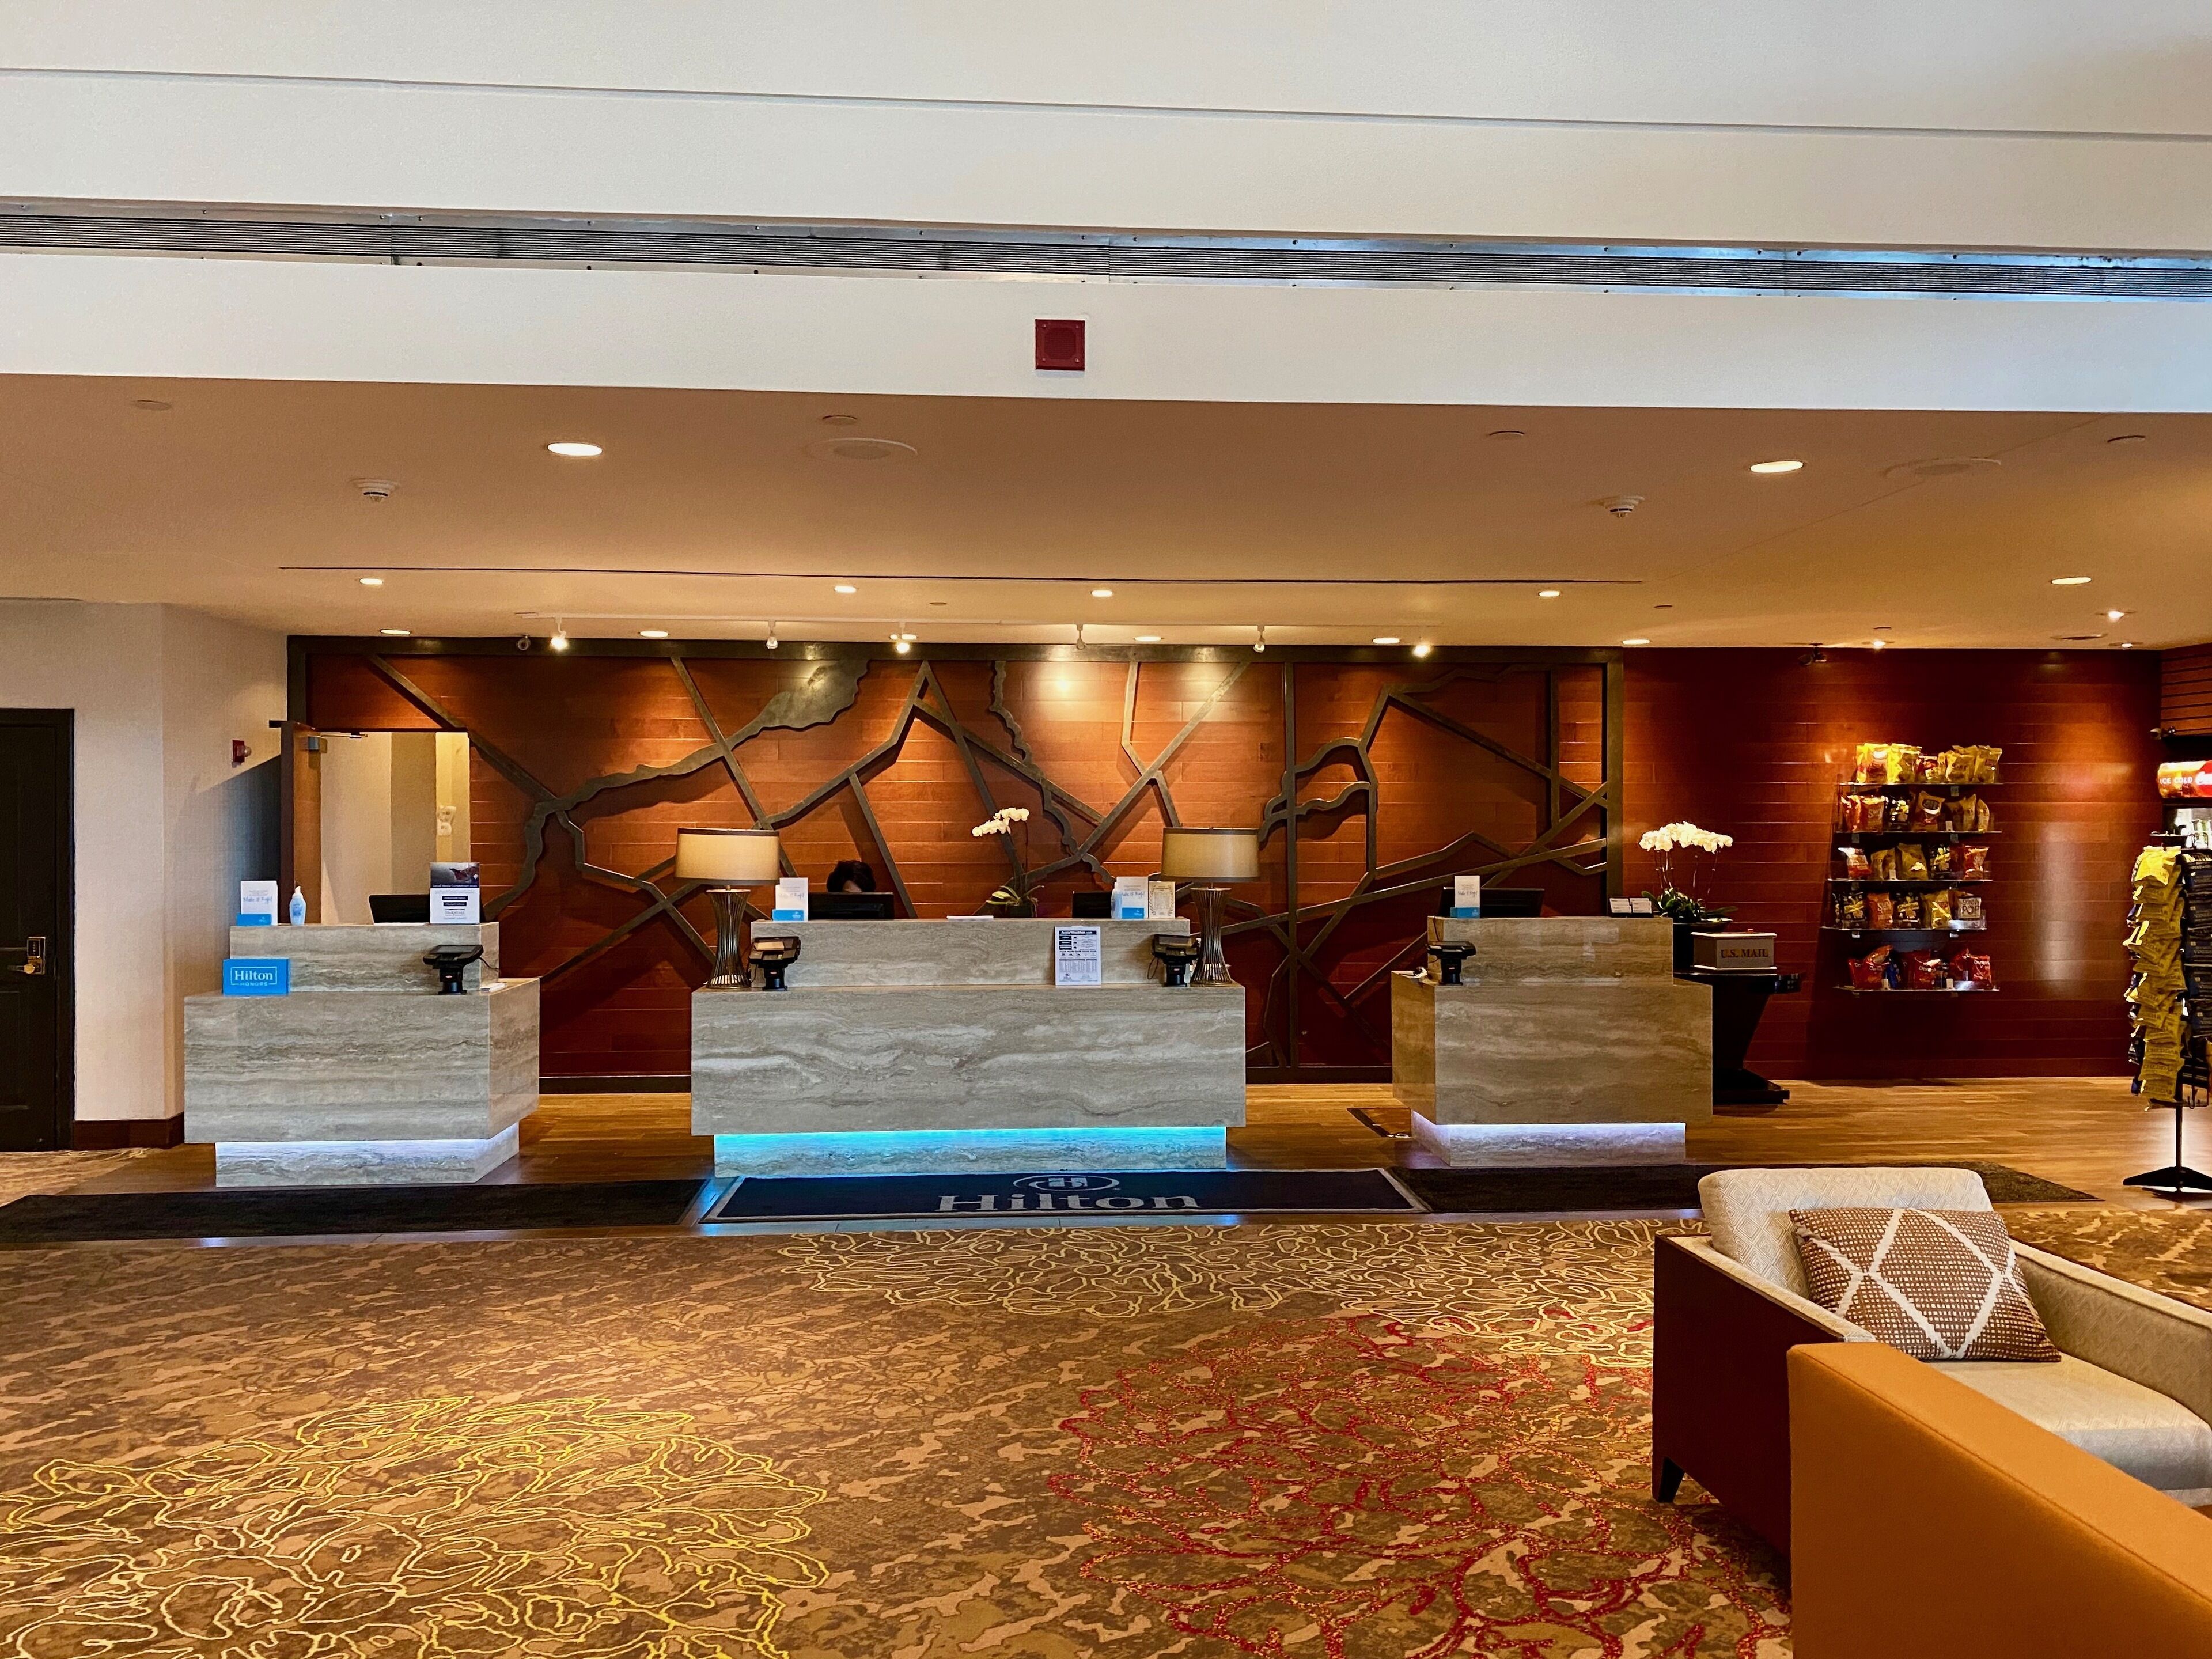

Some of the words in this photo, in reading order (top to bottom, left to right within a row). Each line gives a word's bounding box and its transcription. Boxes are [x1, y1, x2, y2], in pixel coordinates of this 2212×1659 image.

[1962, 905, 1979, 915] POP
[1721, 949, 1738, 958] U.S.
[1741, 949, 1768, 958] MAIL
[234, 970, 274, 980] Hilton
[936, 1194, 1202, 1211] Hilton
